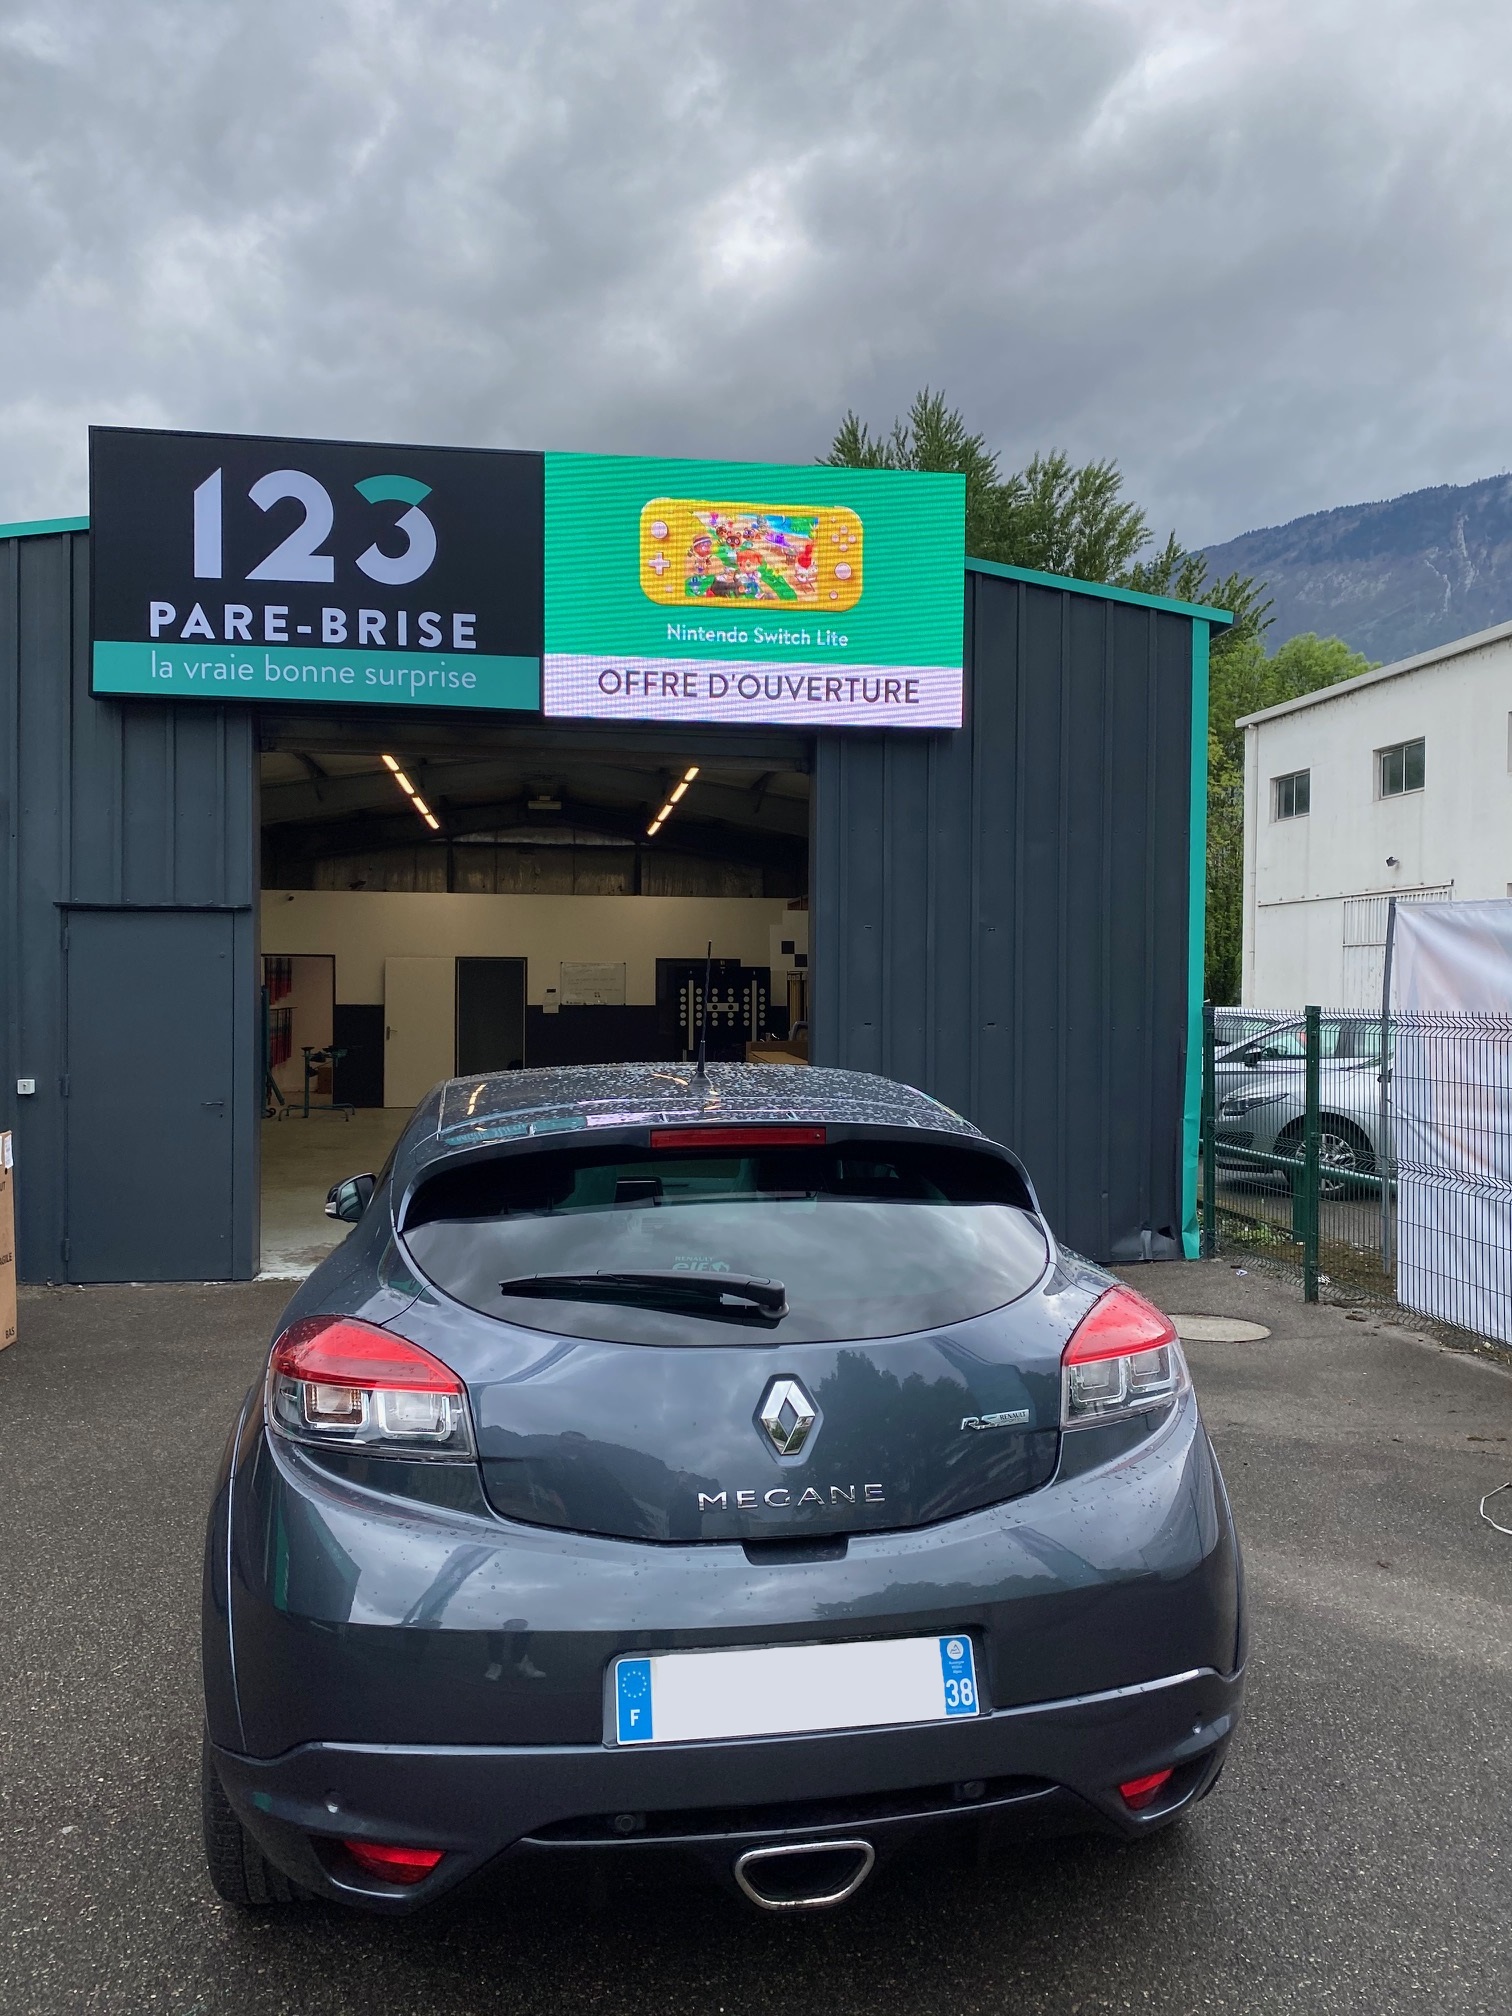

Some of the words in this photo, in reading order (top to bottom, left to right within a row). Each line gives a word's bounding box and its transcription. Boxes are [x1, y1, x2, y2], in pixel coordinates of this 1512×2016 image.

[194, 467, 437, 585] 123
[149, 601, 477, 649] PARE-BRISE
[667, 623, 747, 643] Nintendo
[754, 627, 811, 645] Switch
[817, 630, 848, 647] Lite
[151, 650, 173, 678] la
[183, 654, 254, 681] vraie
[265, 654, 354, 684] bonne
[365, 662, 477, 697] surprise
[598, 669, 698, 697] OFFRE
[709, 673, 920, 704] D'OUVERTURE
[5, 1327, 15, 1340] BAS
[1000, 1412, 1026, 1420] RENAULT
[697, 1484, 886, 1511] MEGANE
[945, 1677, 974, 1707] 38
[629, 1708, 641, 1727] F
